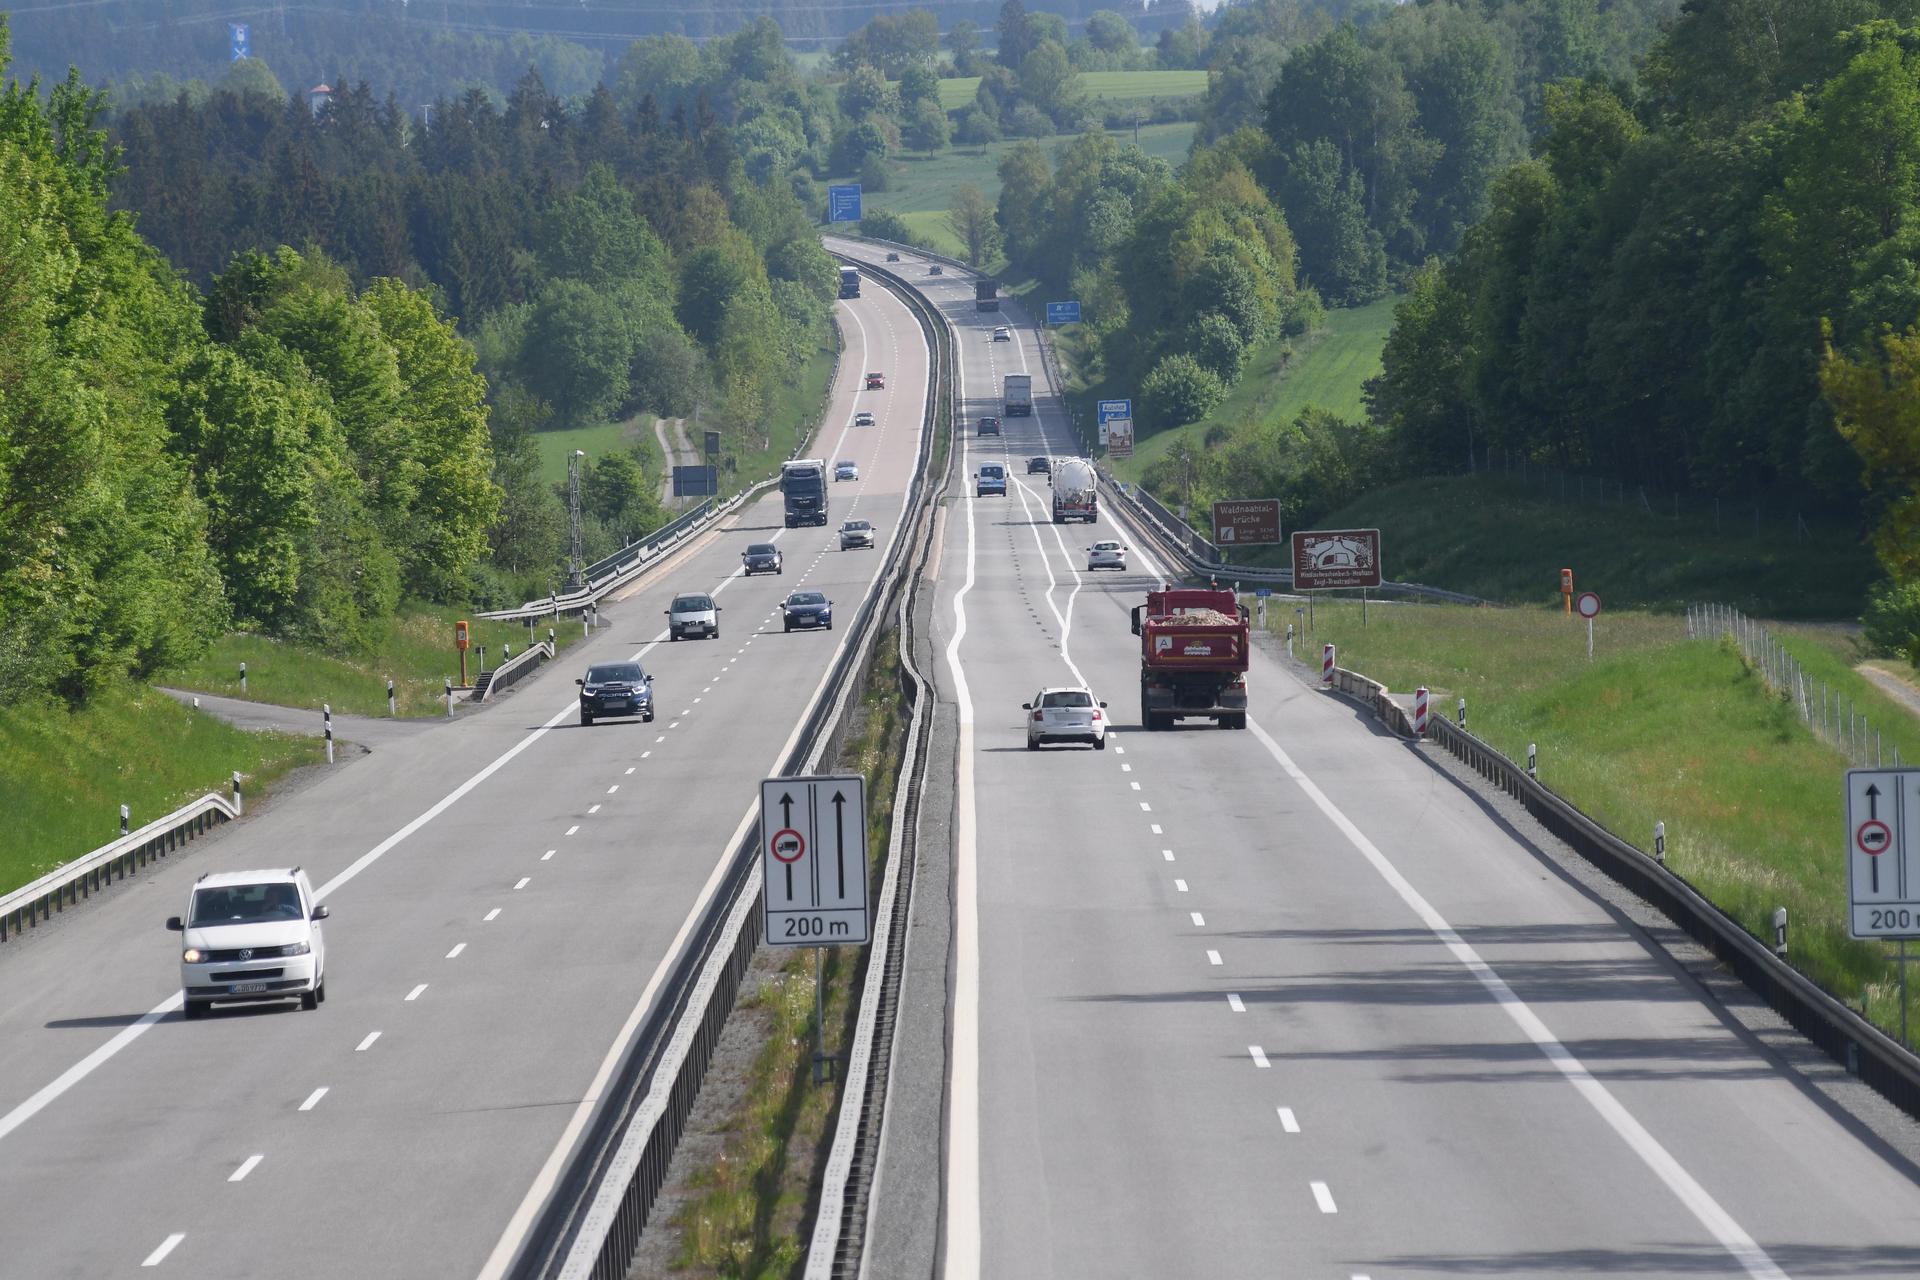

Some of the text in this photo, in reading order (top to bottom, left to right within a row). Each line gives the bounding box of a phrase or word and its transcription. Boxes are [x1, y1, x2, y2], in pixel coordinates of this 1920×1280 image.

[1160, 639, 1168, 647] A
[785, 916, 849, 937] 200 m
[1871, 910, 1910, 930] 200
